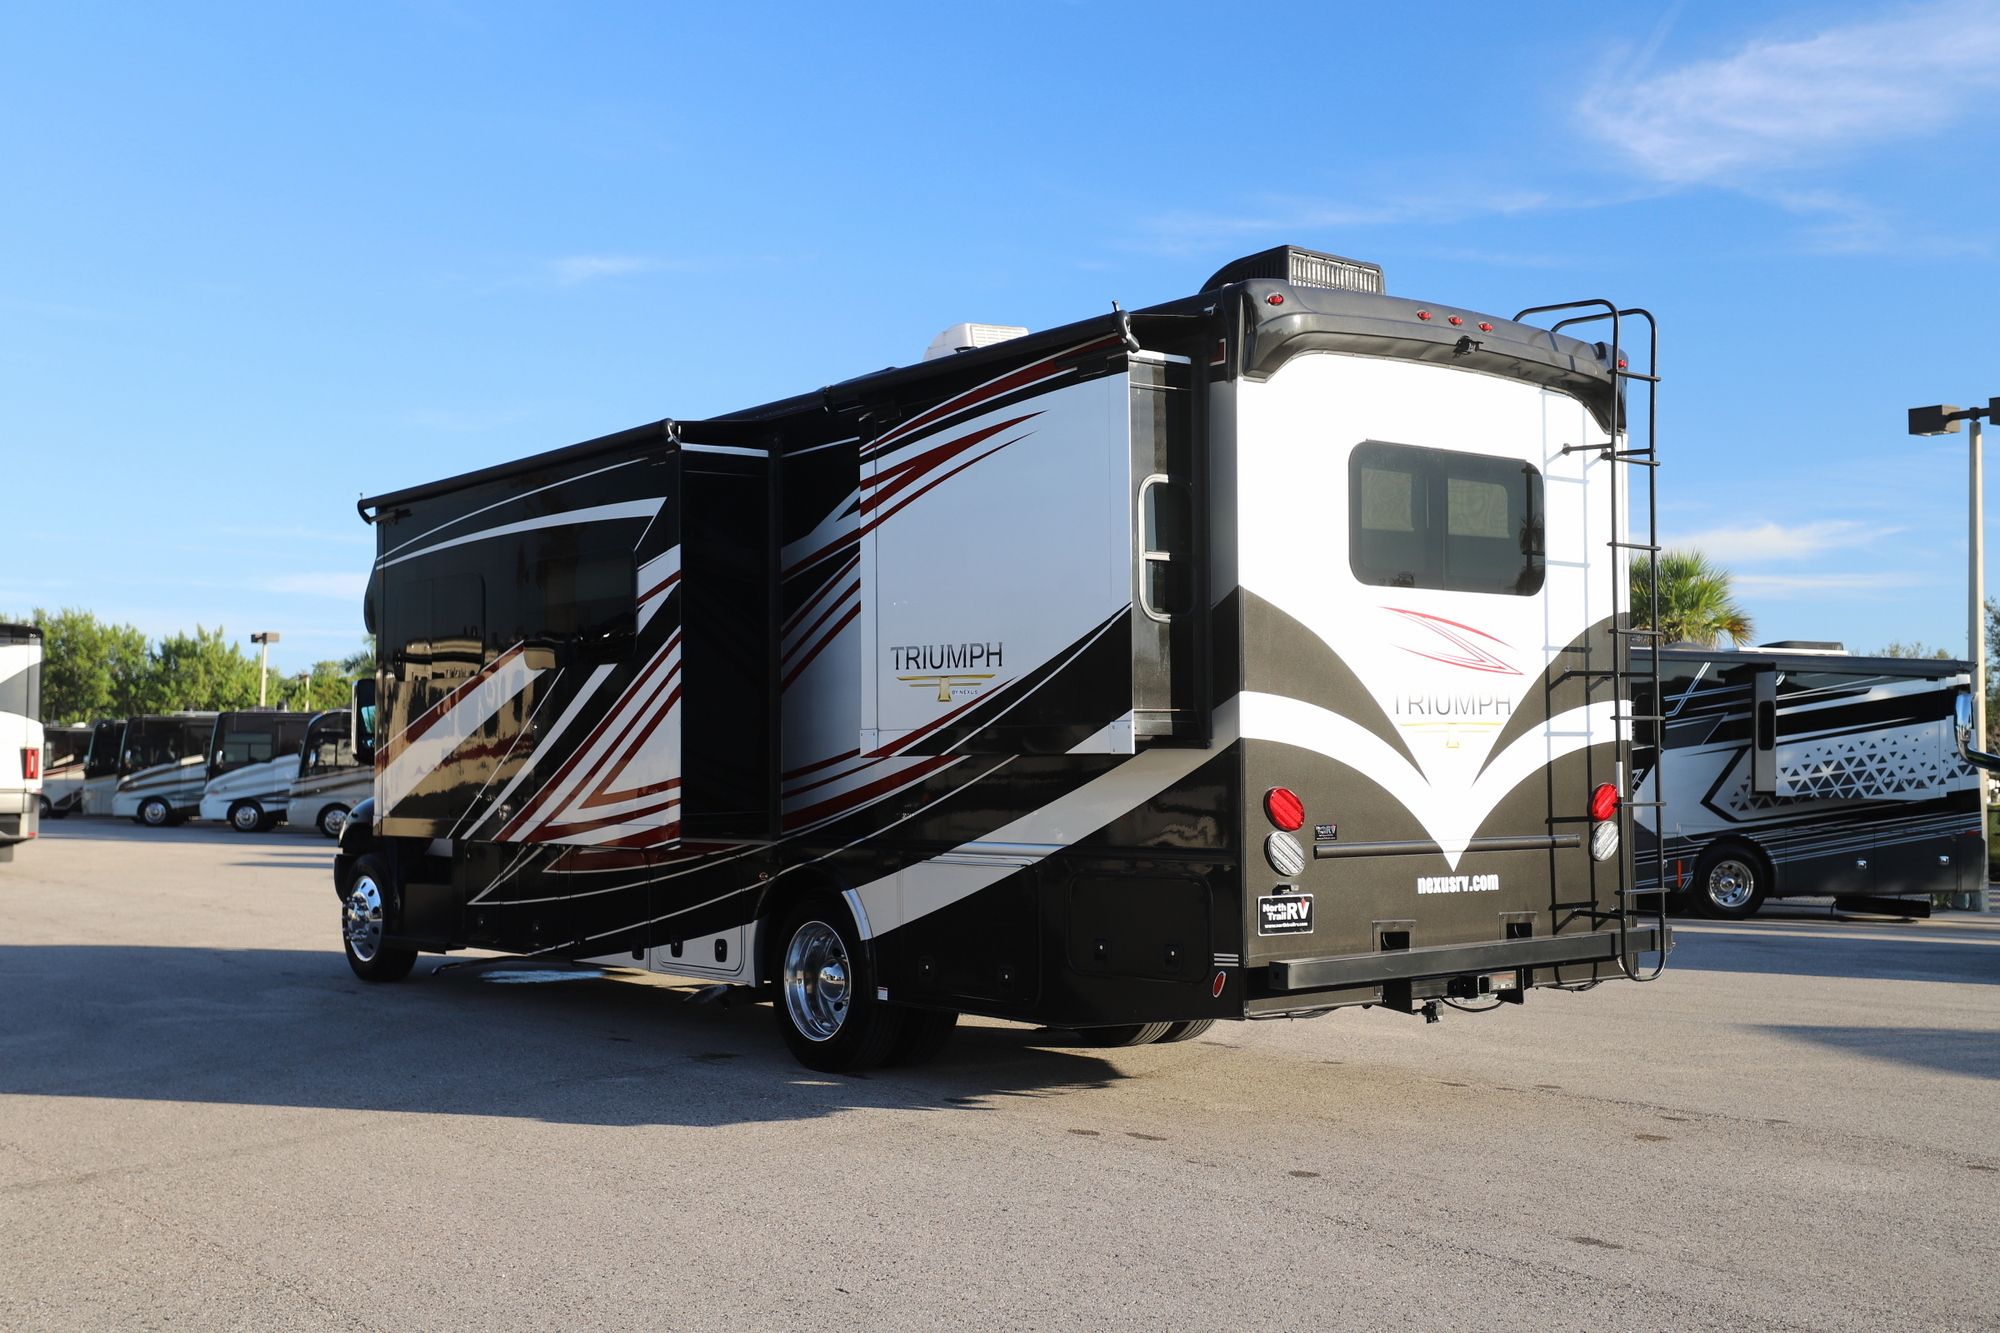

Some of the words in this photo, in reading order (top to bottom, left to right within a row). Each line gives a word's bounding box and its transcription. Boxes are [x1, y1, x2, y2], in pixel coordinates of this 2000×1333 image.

[890, 641, 1003, 670] TRIUMPH
[1417, 874, 1499, 894] nexusrv.com
[1262, 903, 1286, 912] North
[1287, 901, 1310, 920] RV
[1267, 911, 1286, 920] Trail
